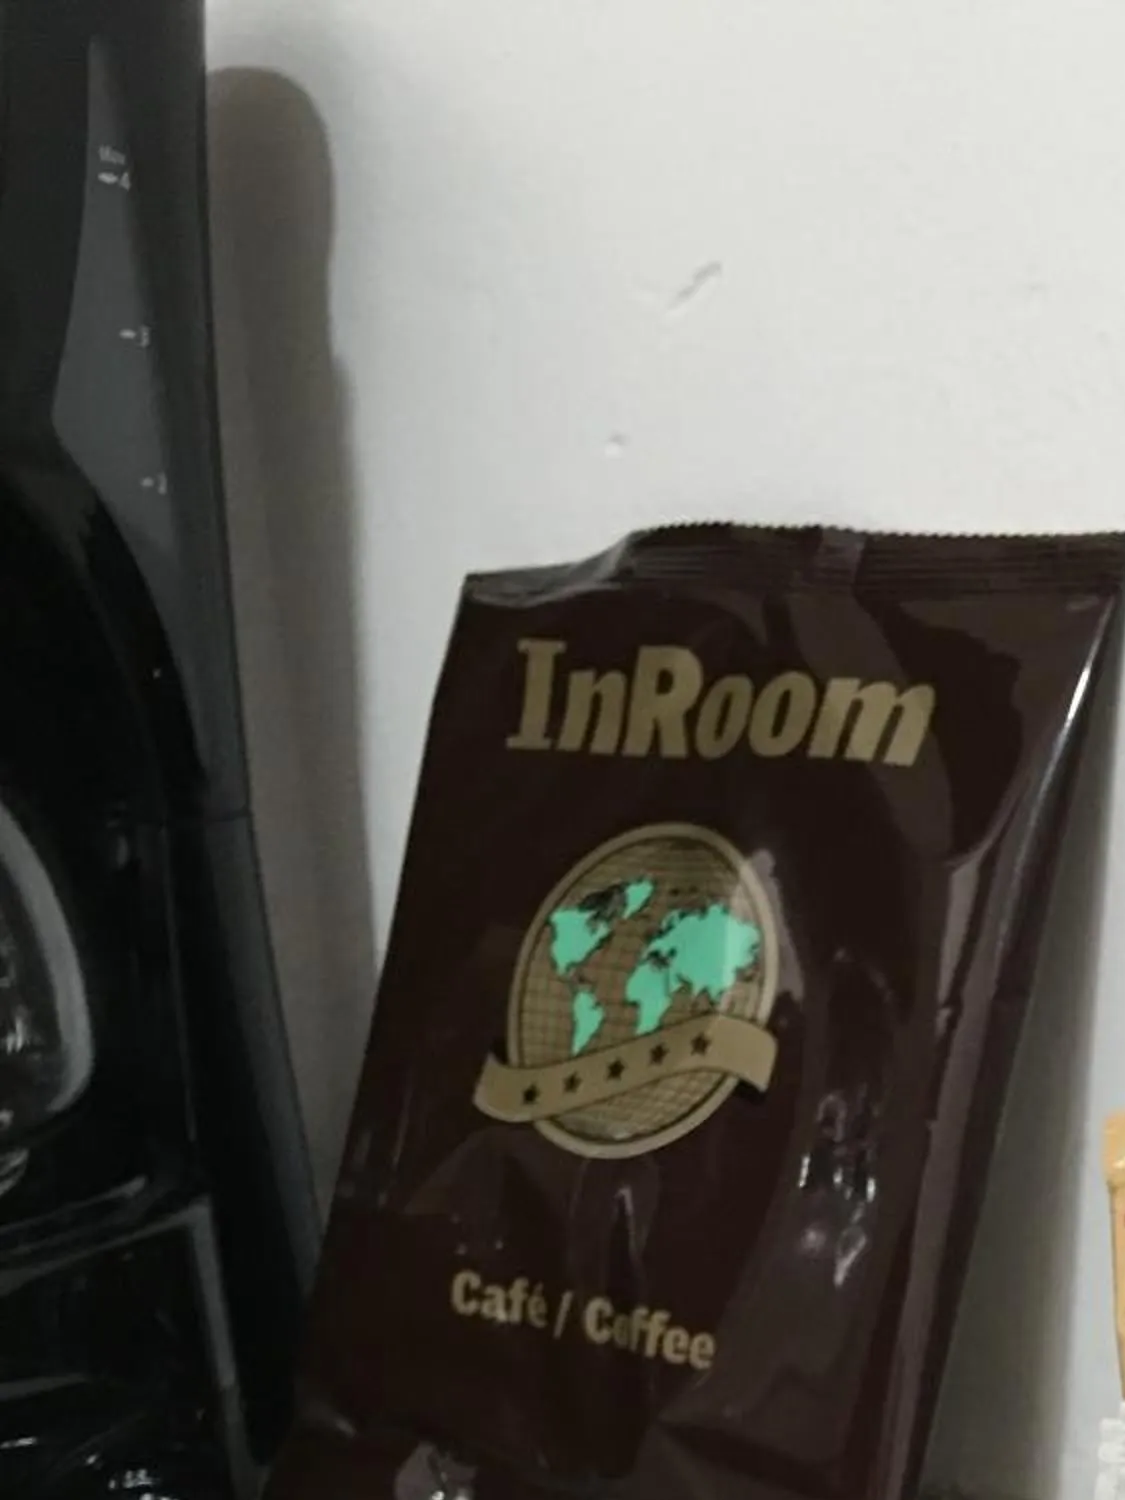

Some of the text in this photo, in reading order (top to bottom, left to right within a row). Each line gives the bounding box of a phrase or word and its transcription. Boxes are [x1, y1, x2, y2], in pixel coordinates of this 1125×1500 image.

[505, 637, 937, 767] InRoom
[452, 1268, 548, 1330] Café
[583, 1296, 716, 1370] Coffee
